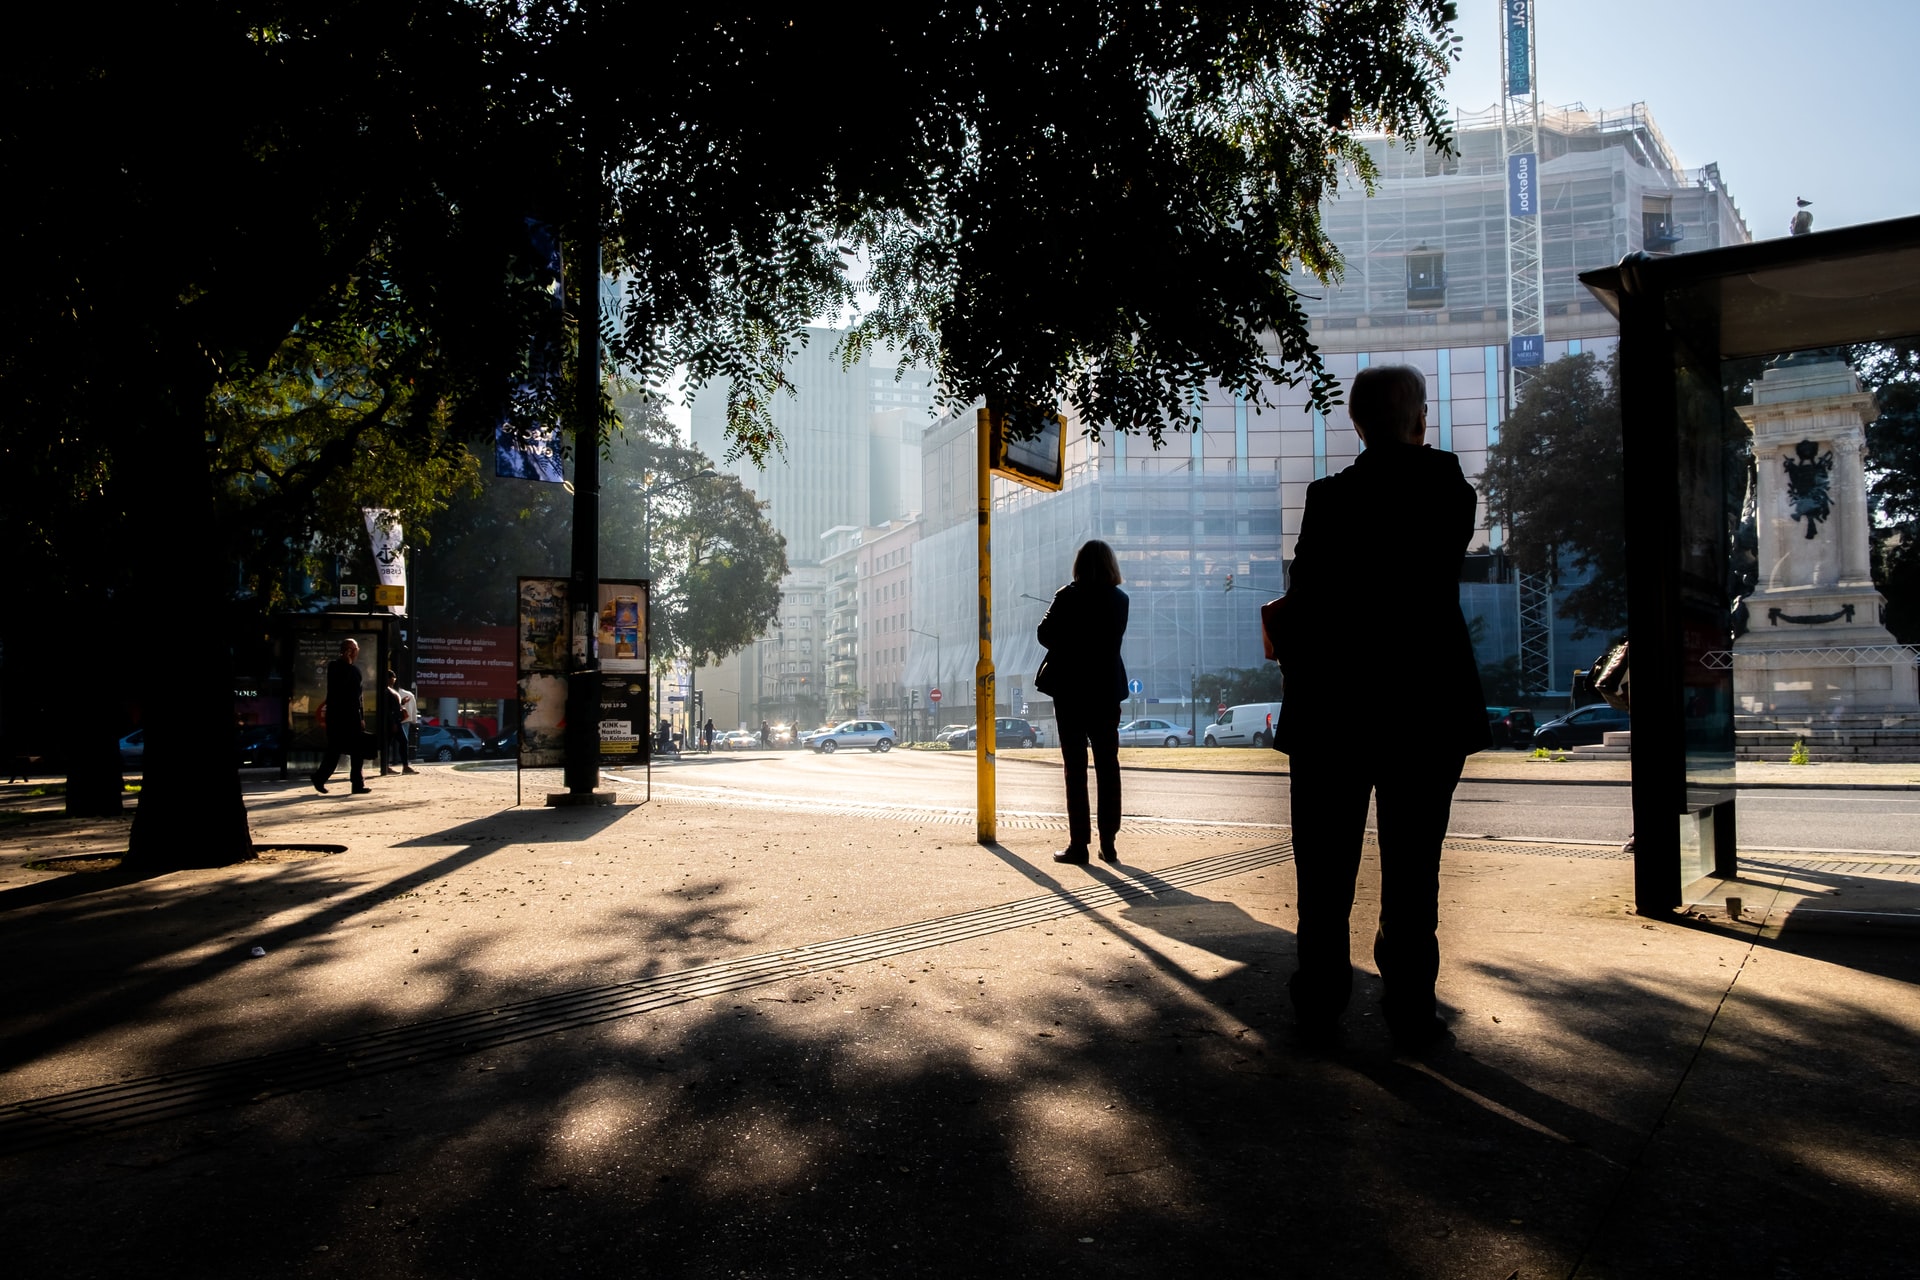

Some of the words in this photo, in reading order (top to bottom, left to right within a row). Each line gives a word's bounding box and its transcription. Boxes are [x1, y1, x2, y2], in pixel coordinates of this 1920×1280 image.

[1512, 0, 1526, 28] cyr
[1517, 157, 1529, 212] engexpor
[417, 636, 446, 644] Aumento
[447, 637, 463, 645] geral
[473, 638, 496, 646] salários
[417, 656, 445, 664] Aumento
[446, 657, 454, 665] de
[456, 658, 481, 666] pensões
[487, 659, 514, 667] reformas
[439, 672, 465, 680] gratuita
